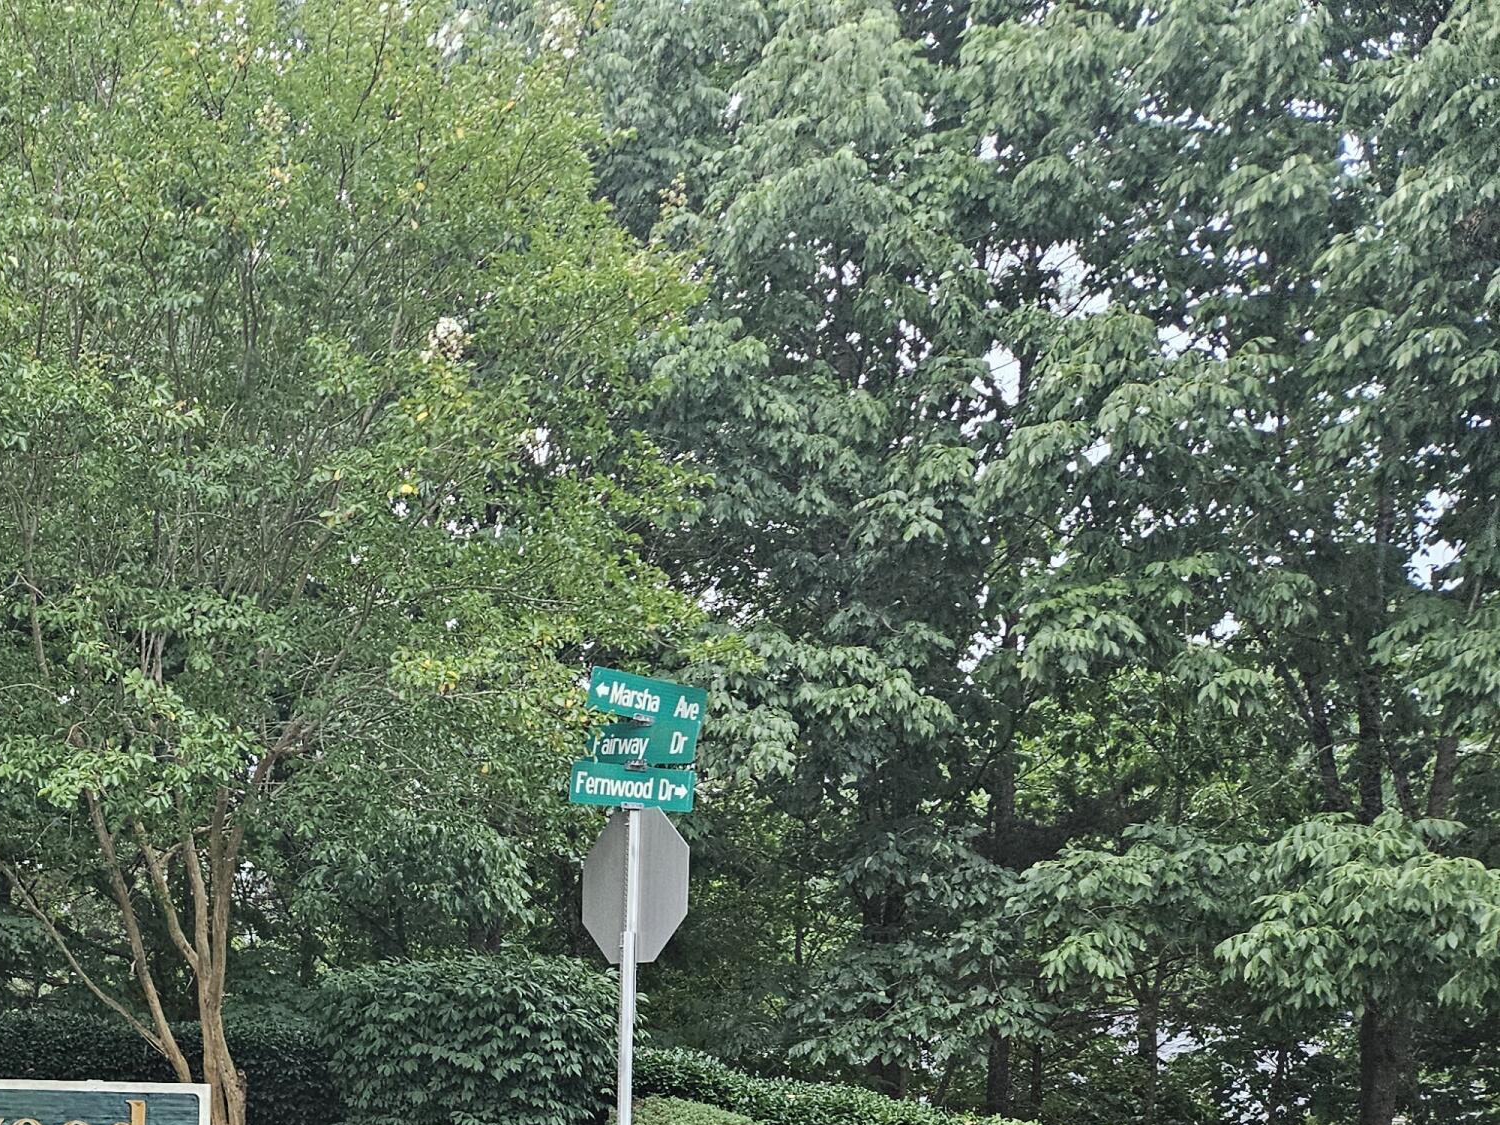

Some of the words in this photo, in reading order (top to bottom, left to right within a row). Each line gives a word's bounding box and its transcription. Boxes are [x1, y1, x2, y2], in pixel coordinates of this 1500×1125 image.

[609, 681, 660, 712] Marsha
[674, 696, 699, 720] Ave
[593, 734, 649, 759] Fairway
[670, 732, 688, 755] Dr
[576, 771, 653, 798] Fernwood
[658, 778, 675, 801] Dr
